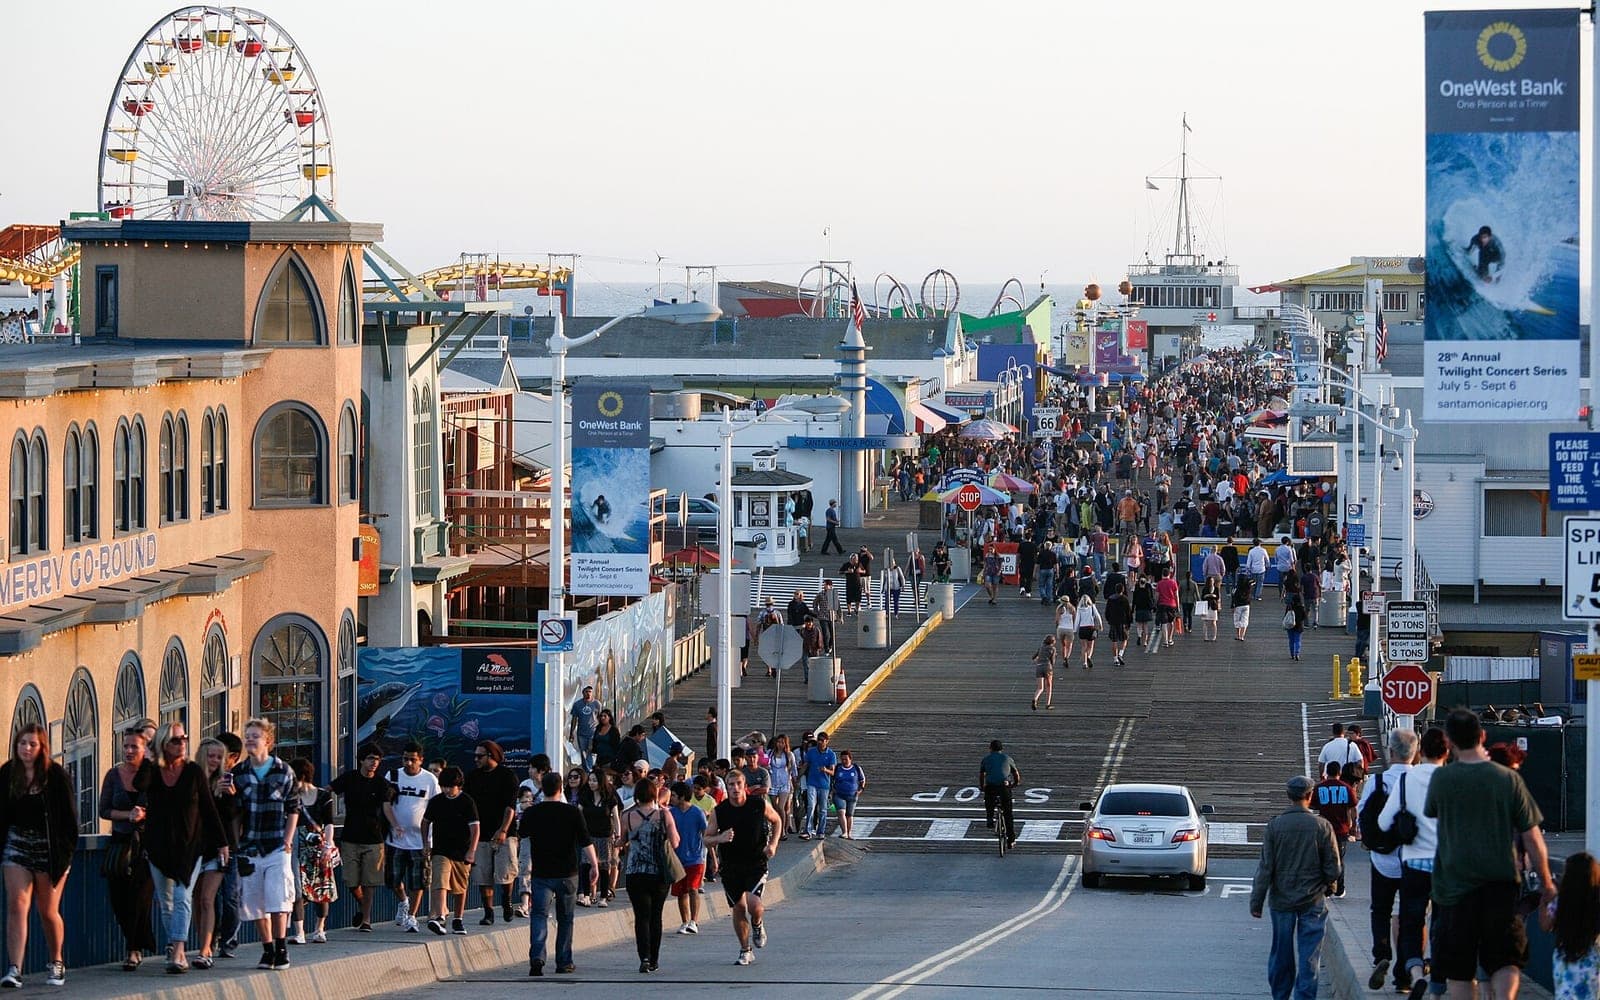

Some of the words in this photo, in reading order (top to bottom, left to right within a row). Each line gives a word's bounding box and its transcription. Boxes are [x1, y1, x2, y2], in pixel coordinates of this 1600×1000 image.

[1440, 80, 1517, 96] OneWest
[1521, 79, 1563, 95] Bank
[1457, 101, 1475, 109] One
[1477, 101, 1507, 109] Person
[1525, 100, 1548, 108] Time
[1438, 352, 1458, 362] 28th
[1461, 353, 1501, 362] Annual
[1438, 367, 1482, 378] Twilight
[1486, 367, 1529, 377] Concert
[1533, 366, 1567, 376] Series
[1437, 381, 1460, 392] July
[1464, 381, 1471, 391] 5
[1481, 381, 1506, 393] Sept
[1509, 381, 1516, 390] 6
[1437, 399, 1548, 411] santamonicapier.org
[579, 420, 618, 430] OneWest
[620, 420, 641, 430] Bank
[1041, 417, 1054, 429] 66
[804, 439, 826, 447] SANTA
[828, 439, 857, 447] MONICA
[861, 439, 887, 447] POLICE
[1555, 440, 1589, 450] PLEASE
[1556, 451, 1569, 461] DO
[1571, 451, 1588, 461] NOT
[1561, 462, 1584, 472] FEED
[1564, 474, 1581, 484] THE
[1558, 485, 1588, 495] BIRDS.
[961, 492, 980, 502] STOP
[1570, 528, 1600, 543] SP
[0, 555, 64, 607] MERRY
[70, 533, 157, 588] GO-ROUND
[1391, 621, 1399, 629] 10
[1402, 621, 1424, 629] TONS
[1391, 649, 1397, 657] 3
[1401, 649, 1423, 657] TONS
[478, 663, 489, 672] Al
[491, 664, 512, 673] Mare
[1385, 680, 1429, 699] STOP
[910, 787, 1053, 803] SOP
